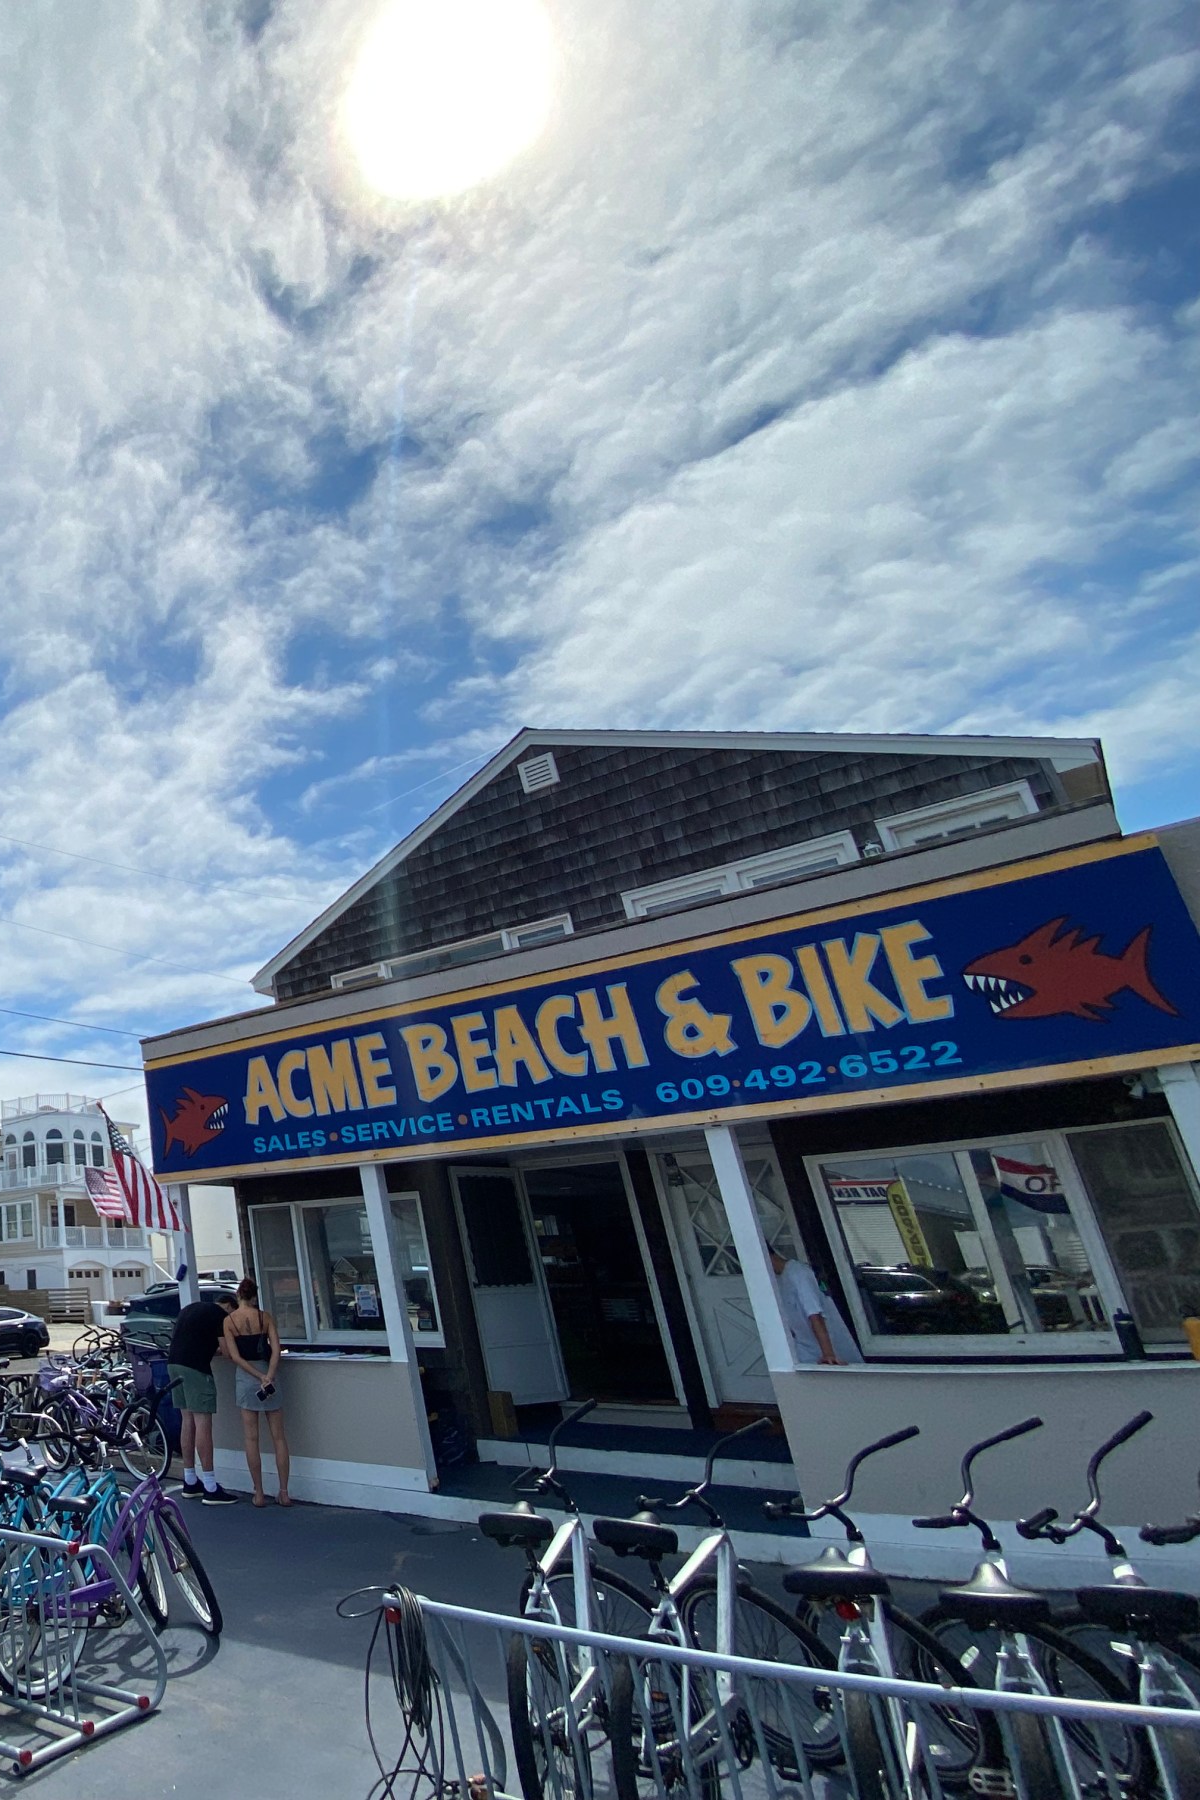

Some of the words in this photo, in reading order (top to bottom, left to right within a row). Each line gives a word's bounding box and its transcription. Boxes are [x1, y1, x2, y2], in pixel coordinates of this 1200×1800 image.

[242, 1032, 397, 1126] ACME
[398, 982, 650, 1102] BEACH
[656, 970, 738, 1059] &
[731, 920, 954, 1048] BIKE
[253, 1127, 326, 1154] SALES
[341, 1112, 455, 1144] SERVICE
[471, 1089, 624, 1128] RENTALS
